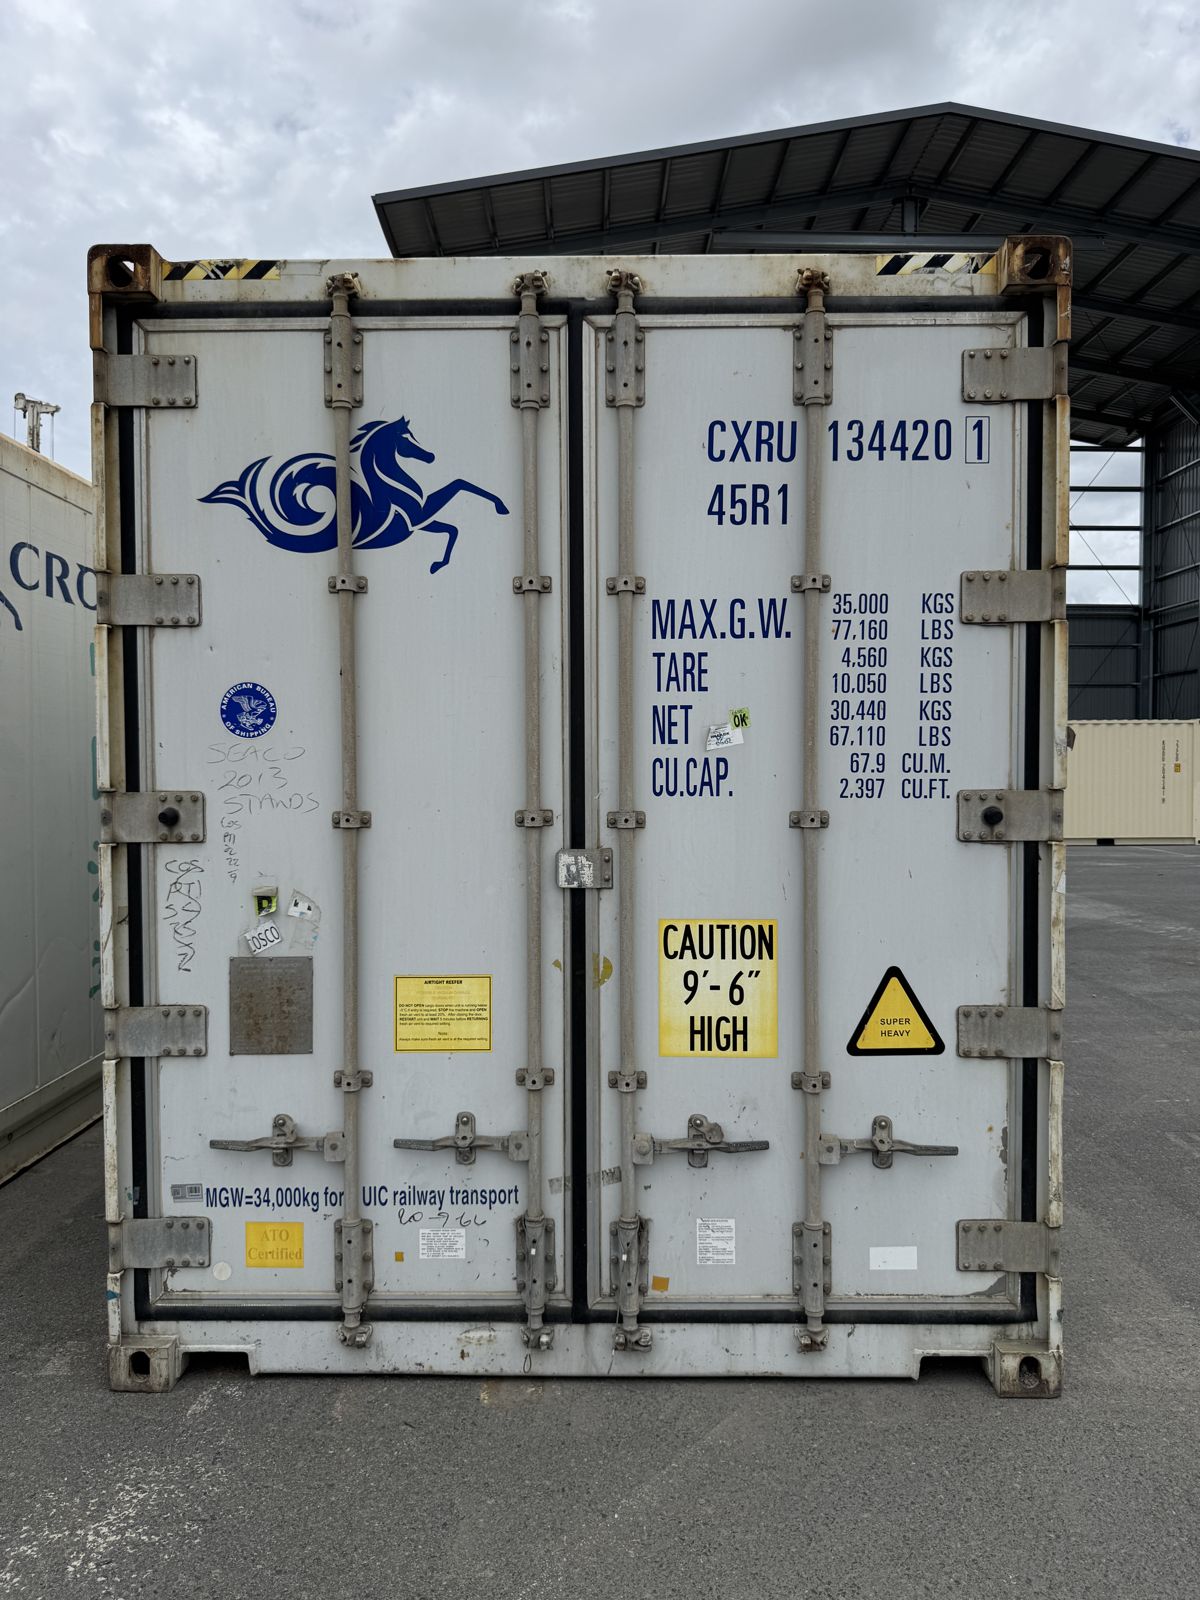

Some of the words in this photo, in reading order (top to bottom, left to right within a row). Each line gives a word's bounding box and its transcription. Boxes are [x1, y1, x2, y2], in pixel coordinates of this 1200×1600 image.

[707, 420, 798, 463] CXRU
[827, 419, 953, 462] 134420
[971, 419, 986, 461] 1
[707, 483, 790, 526] 45R1
[832, 593, 889, 614] 35,000
[921, 593, 954, 614] KGS
[651, 598, 792, 640] MAX.G.W.
[831, 619, 888, 640] 77,160
[921, 619, 954, 640] LBS
[841, 647, 887, 668] 4,560
[920, 646, 953, 668] KGS
[652, 652, 709, 692] TARE
[832, 673, 887, 694] 10,050
[919, 673, 953, 693] LBS
[221, 683, 253, 711] AMERICAN
[733, 713, 748, 728] OK
[830, 700, 886, 721] 30,440
[919, 700, 952, 721] KGS
[652, 704, 693, 745] NET
[829, 725, 886, 746] 67,110
[918, 726, 951, 746] LBS
[850, 752, 886, 773] 67.9
[901, 753, 951, 773] CU.M.
[652, 757, 734, 797] CU.CAP.
[839, 778, 885, 799] 2,397
[901, 778, 951, 799] CU.FT.
[663, 924, 774, 961] CAUTION
[880, 1017, 911, 1027] SUPER
[689, 1015, 748, 1052] HIGH
[880, 1028, 911, 1038] HEAVY
[206, 1187, 319, 1212] MGW=34,000kg
[324, 1187, 344, 1207] for
[363, 1186, 388, 1206] UIC
[393, 1186, 445, 1211] railway
[450, 1185, 519, 1210] transport
[261, 1229, 289, 1242] ATO
[248, 1247, 303, 1260] Certified
